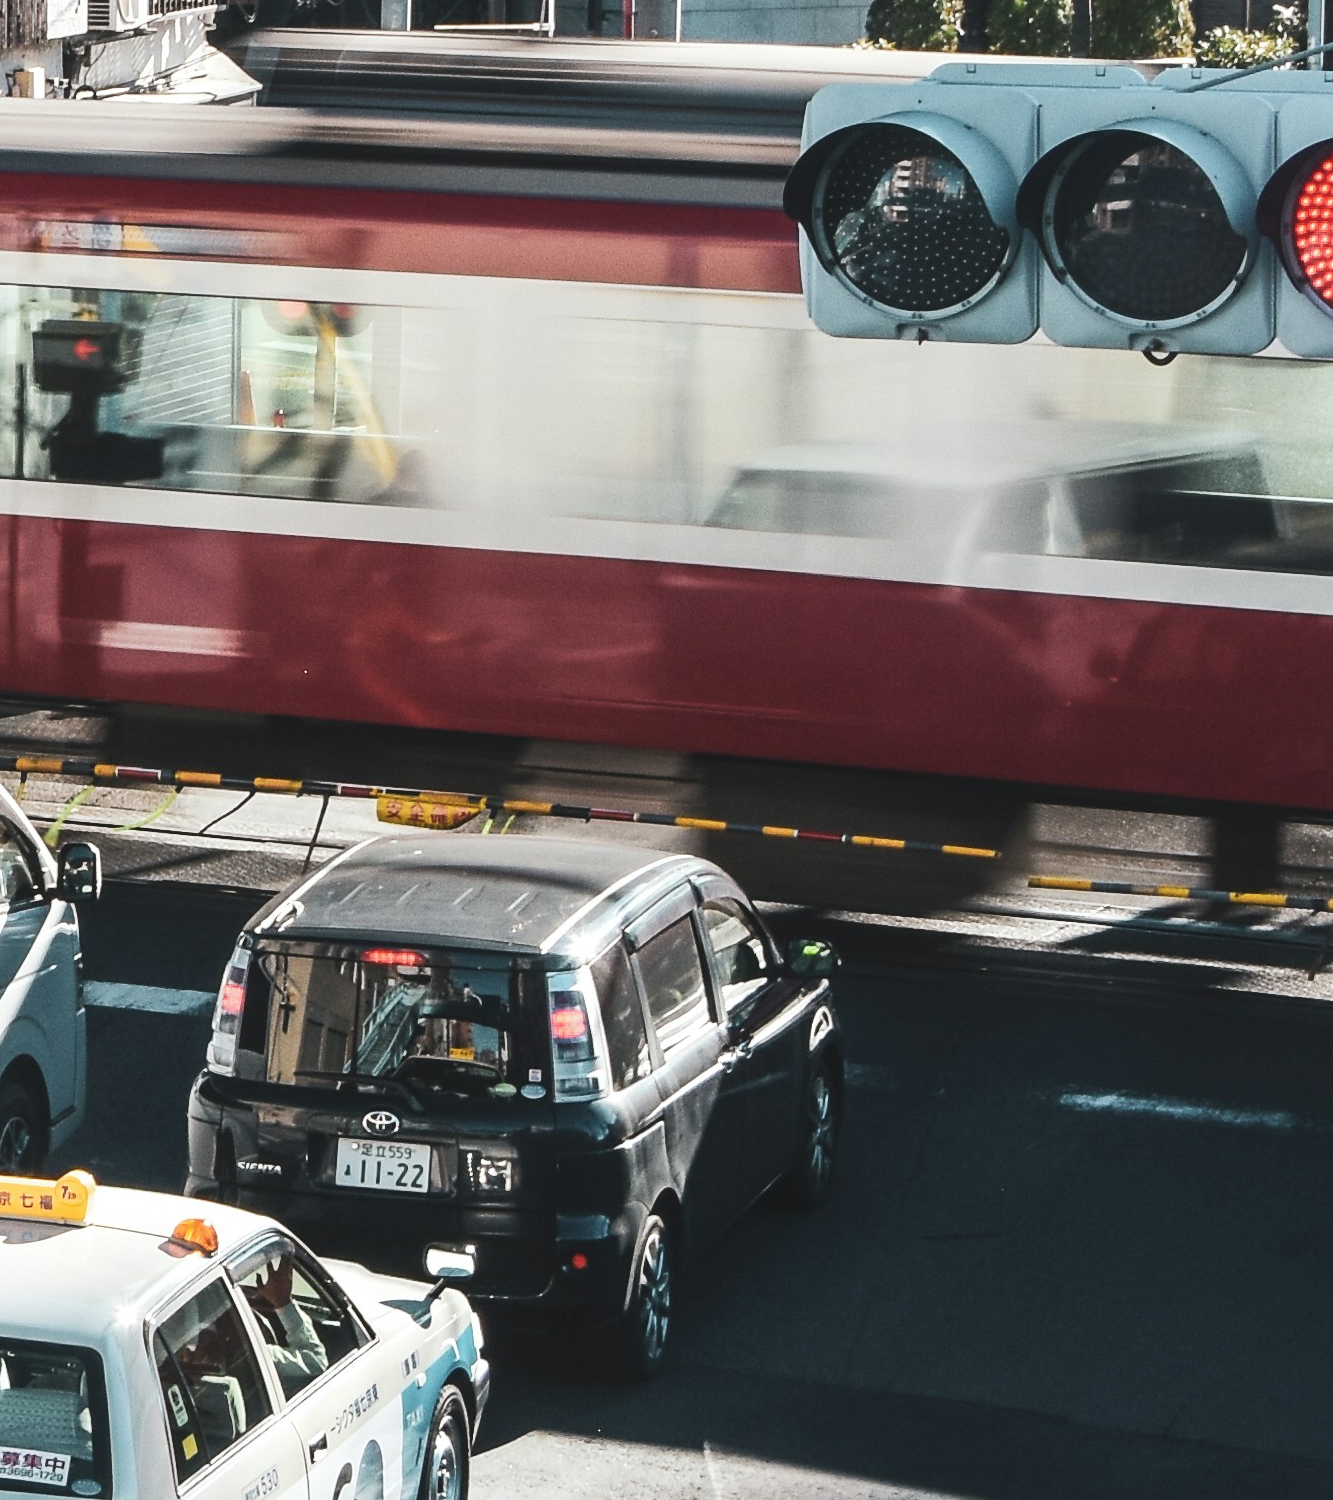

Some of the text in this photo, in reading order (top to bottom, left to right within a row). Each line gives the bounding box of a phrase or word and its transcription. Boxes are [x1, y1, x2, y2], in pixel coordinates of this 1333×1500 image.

[237, 1161, 282, 1175] SIENTA
[360, 1159, 424, 1188] 11-22
[261, 1467, 279, 1495] 530
